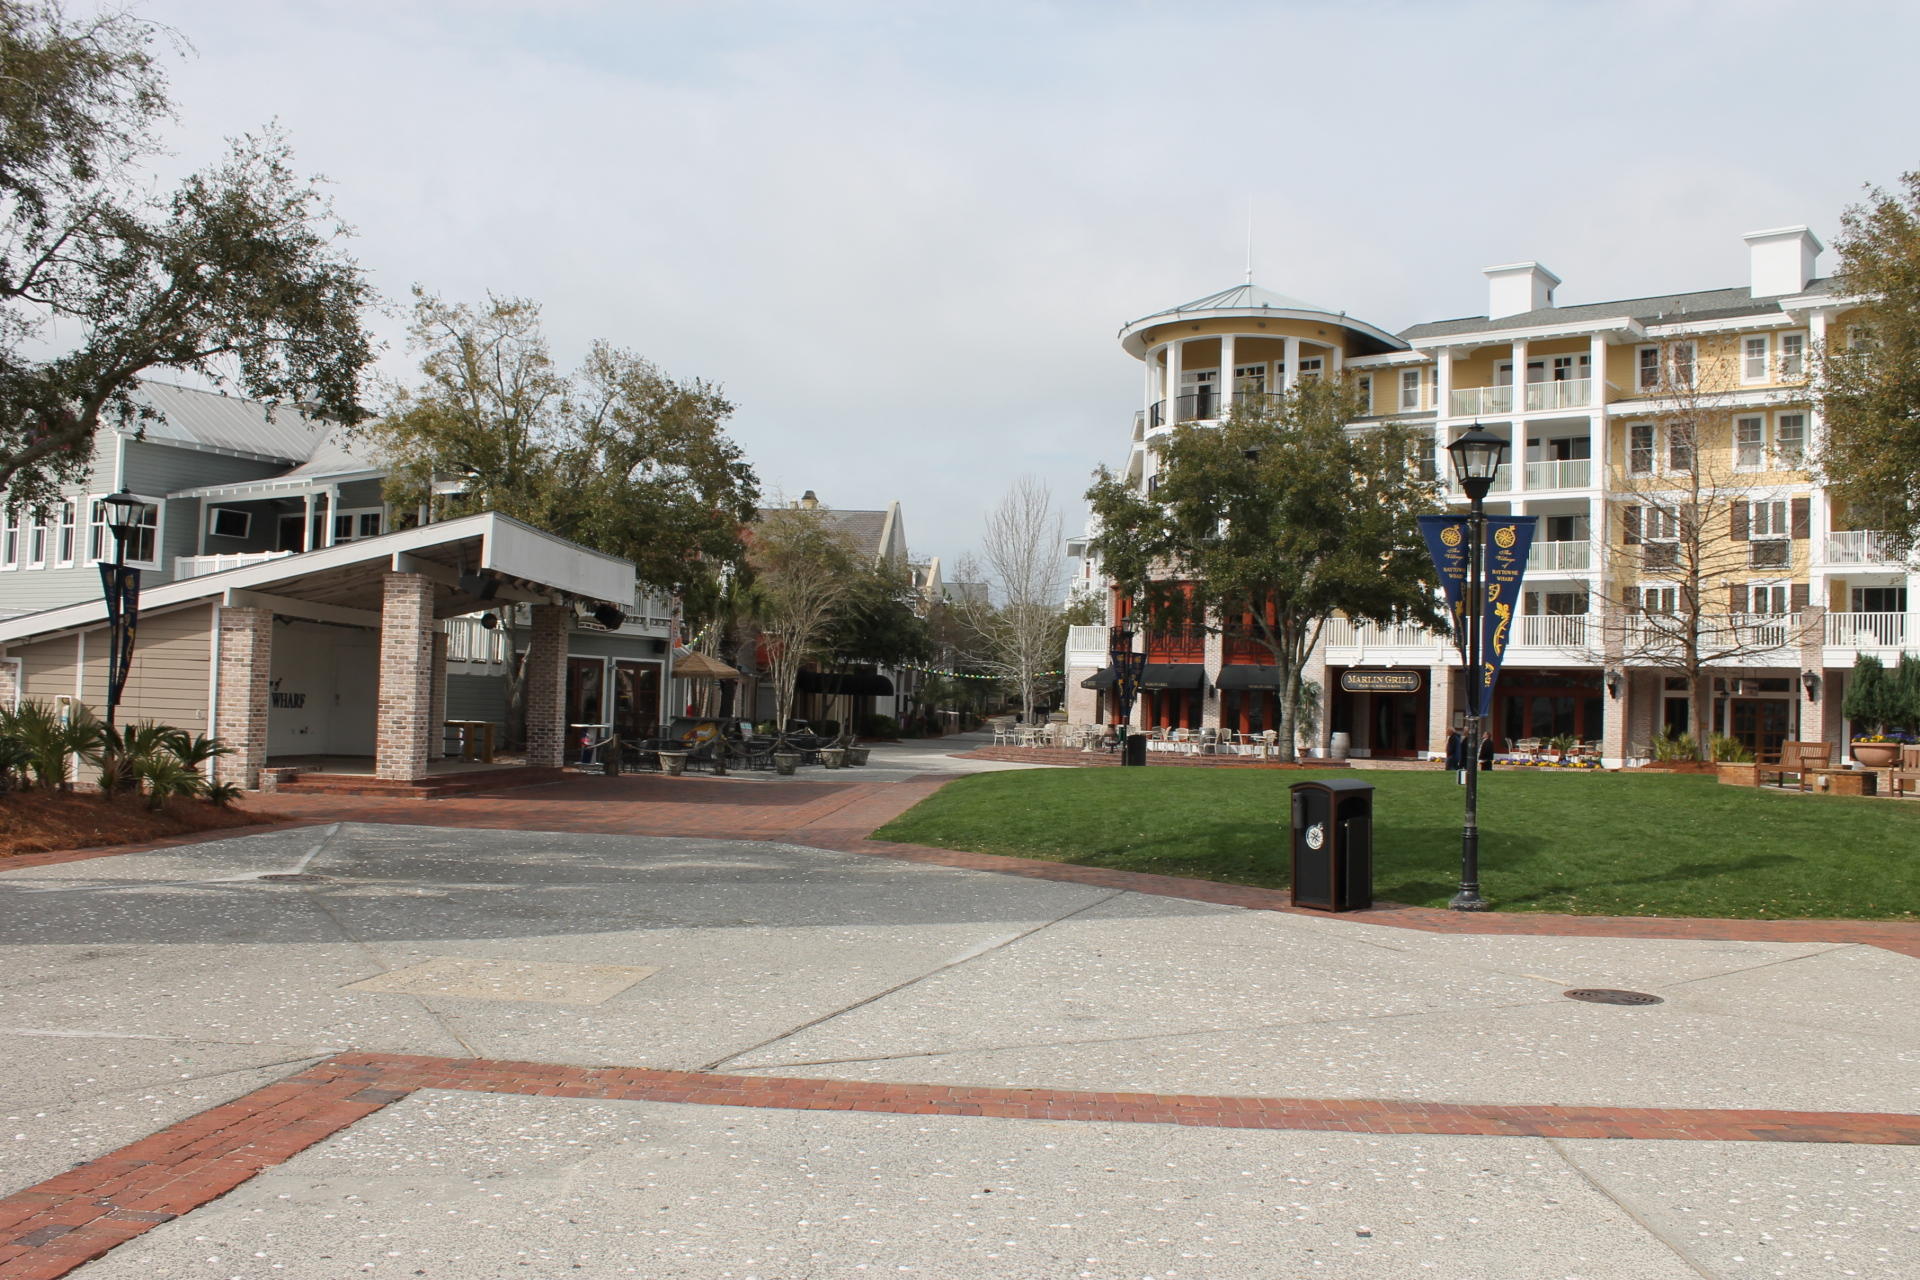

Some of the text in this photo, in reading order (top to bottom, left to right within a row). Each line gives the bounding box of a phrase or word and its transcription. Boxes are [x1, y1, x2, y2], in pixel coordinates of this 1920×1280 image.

[1347, 675, 1414, 684] MARLIN GRILL
[271, 693, 306, 709] WHARF
